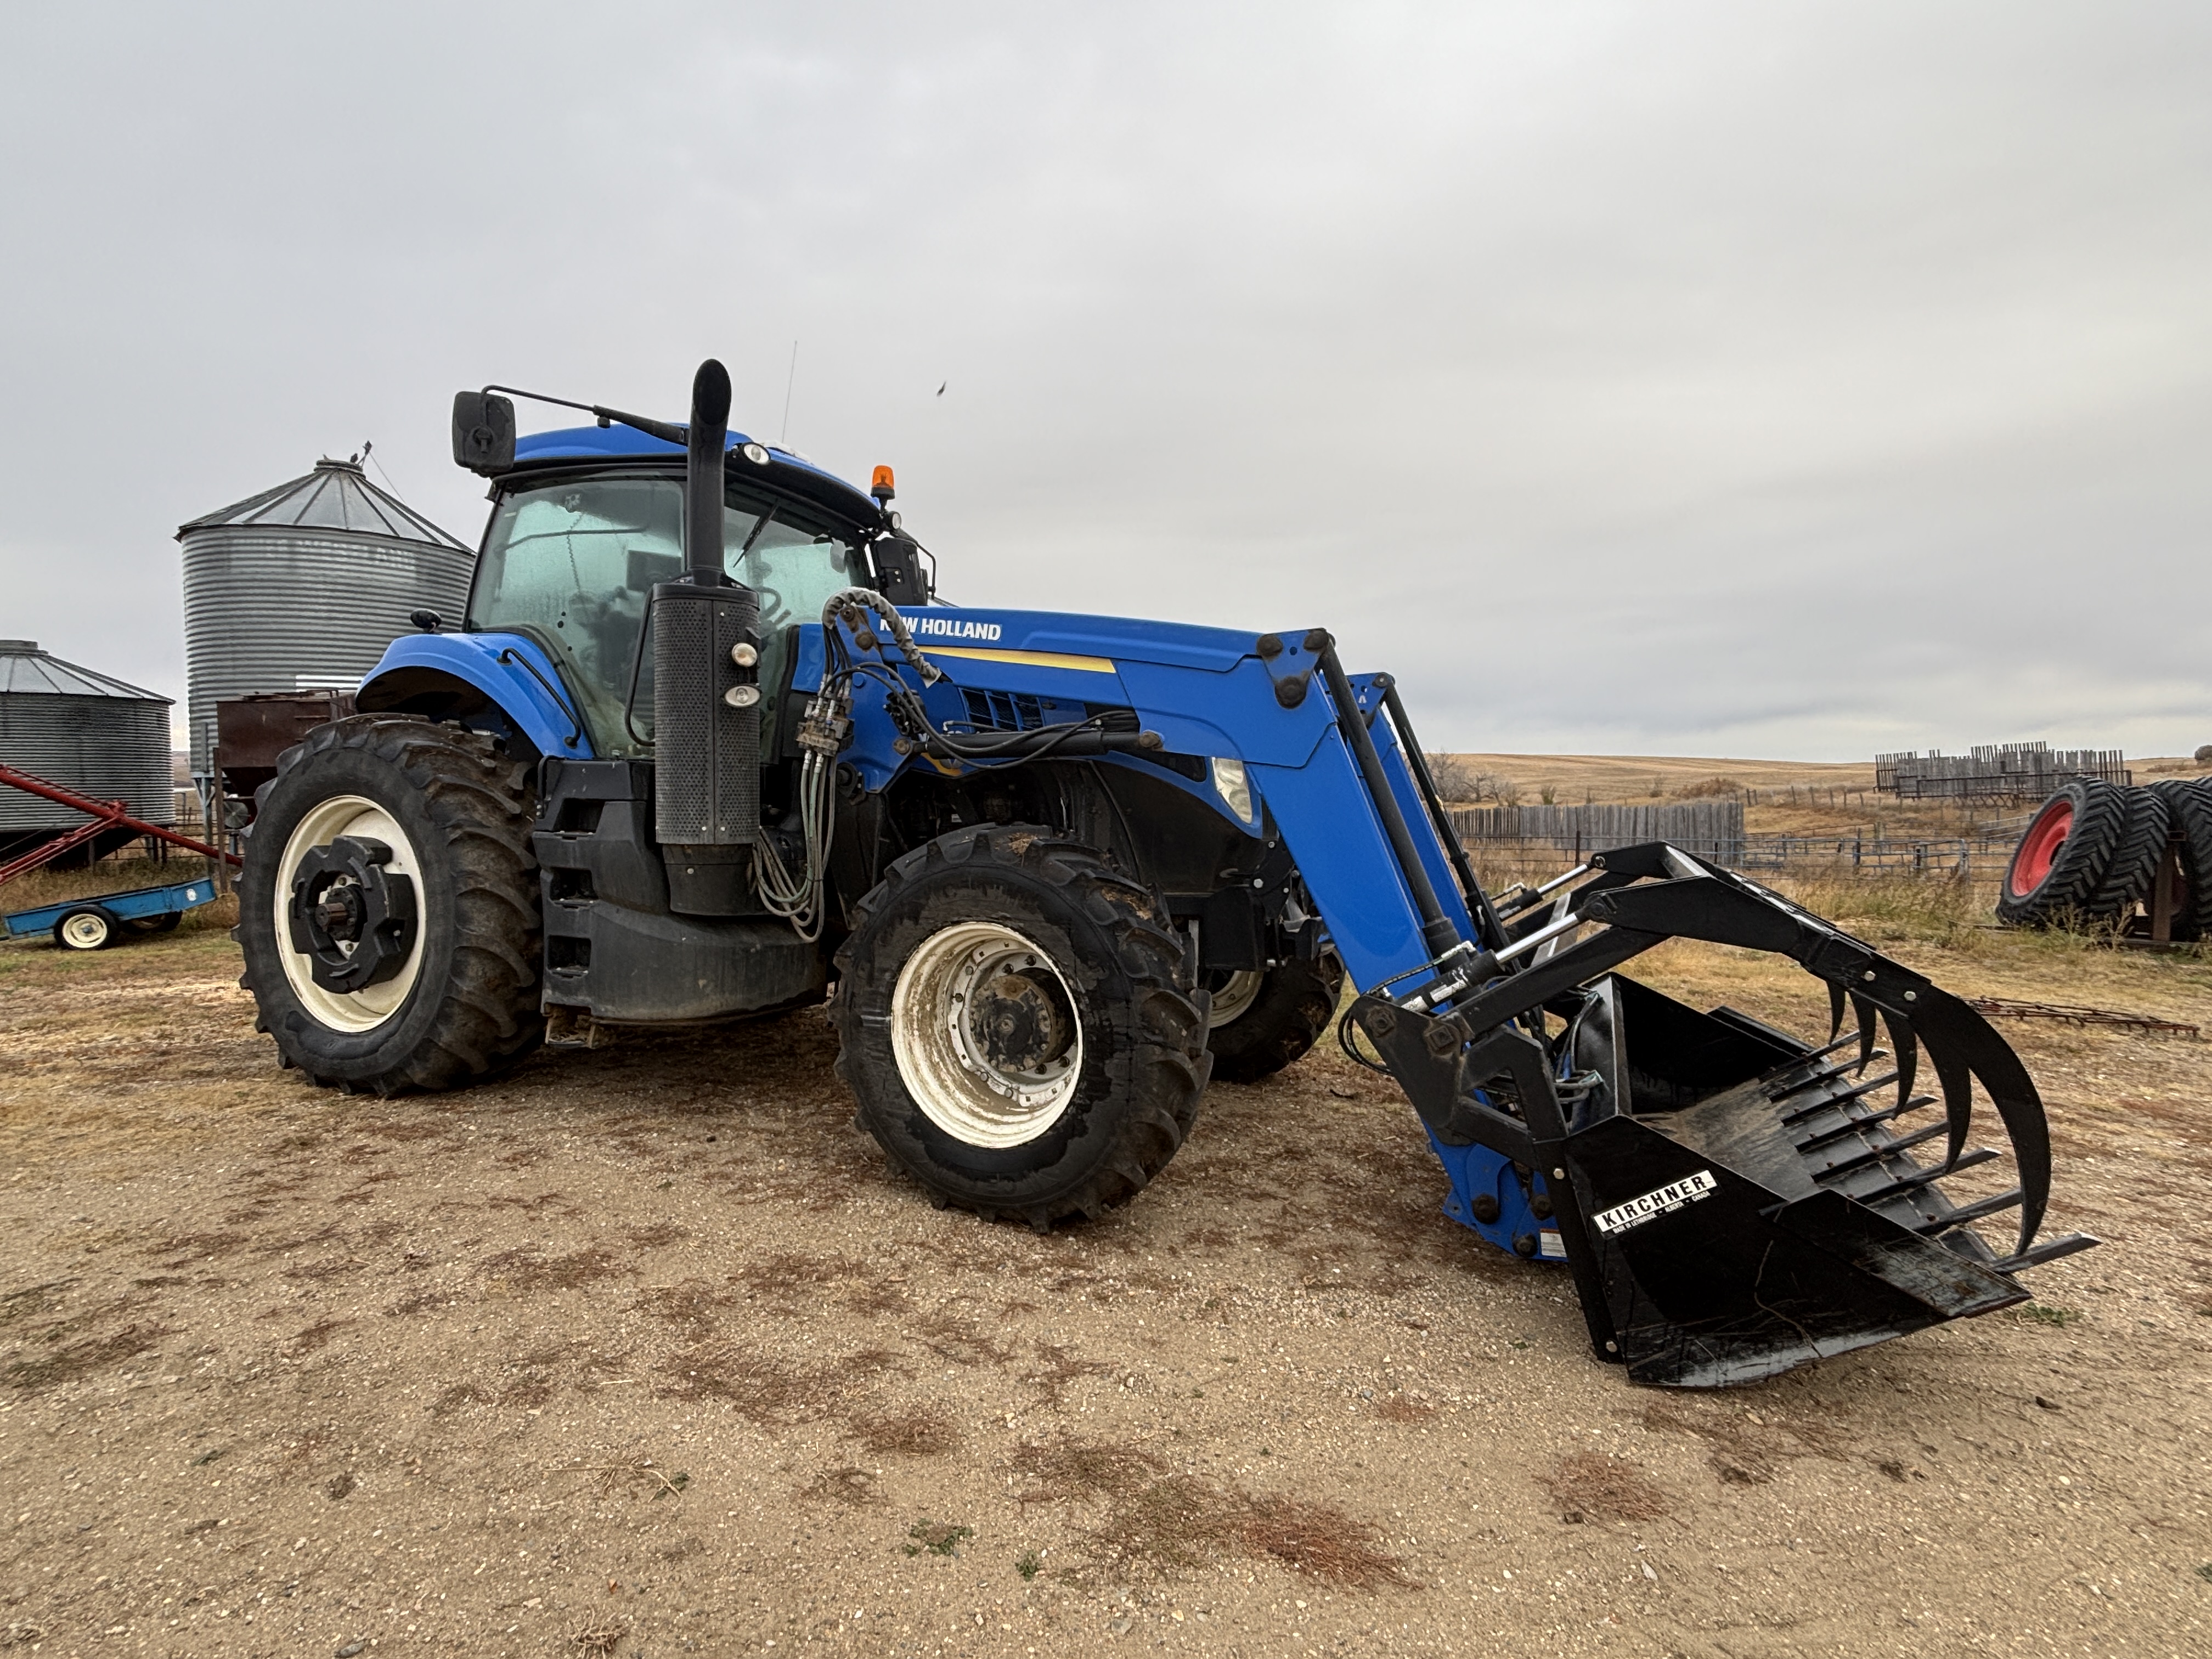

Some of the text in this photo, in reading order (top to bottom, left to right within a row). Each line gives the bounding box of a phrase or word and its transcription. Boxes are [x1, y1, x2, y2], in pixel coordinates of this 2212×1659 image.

[880, 617, 1001, 641] NW HOLLAND
[1601, 1176, 1707, 1228] KIRCHNER
